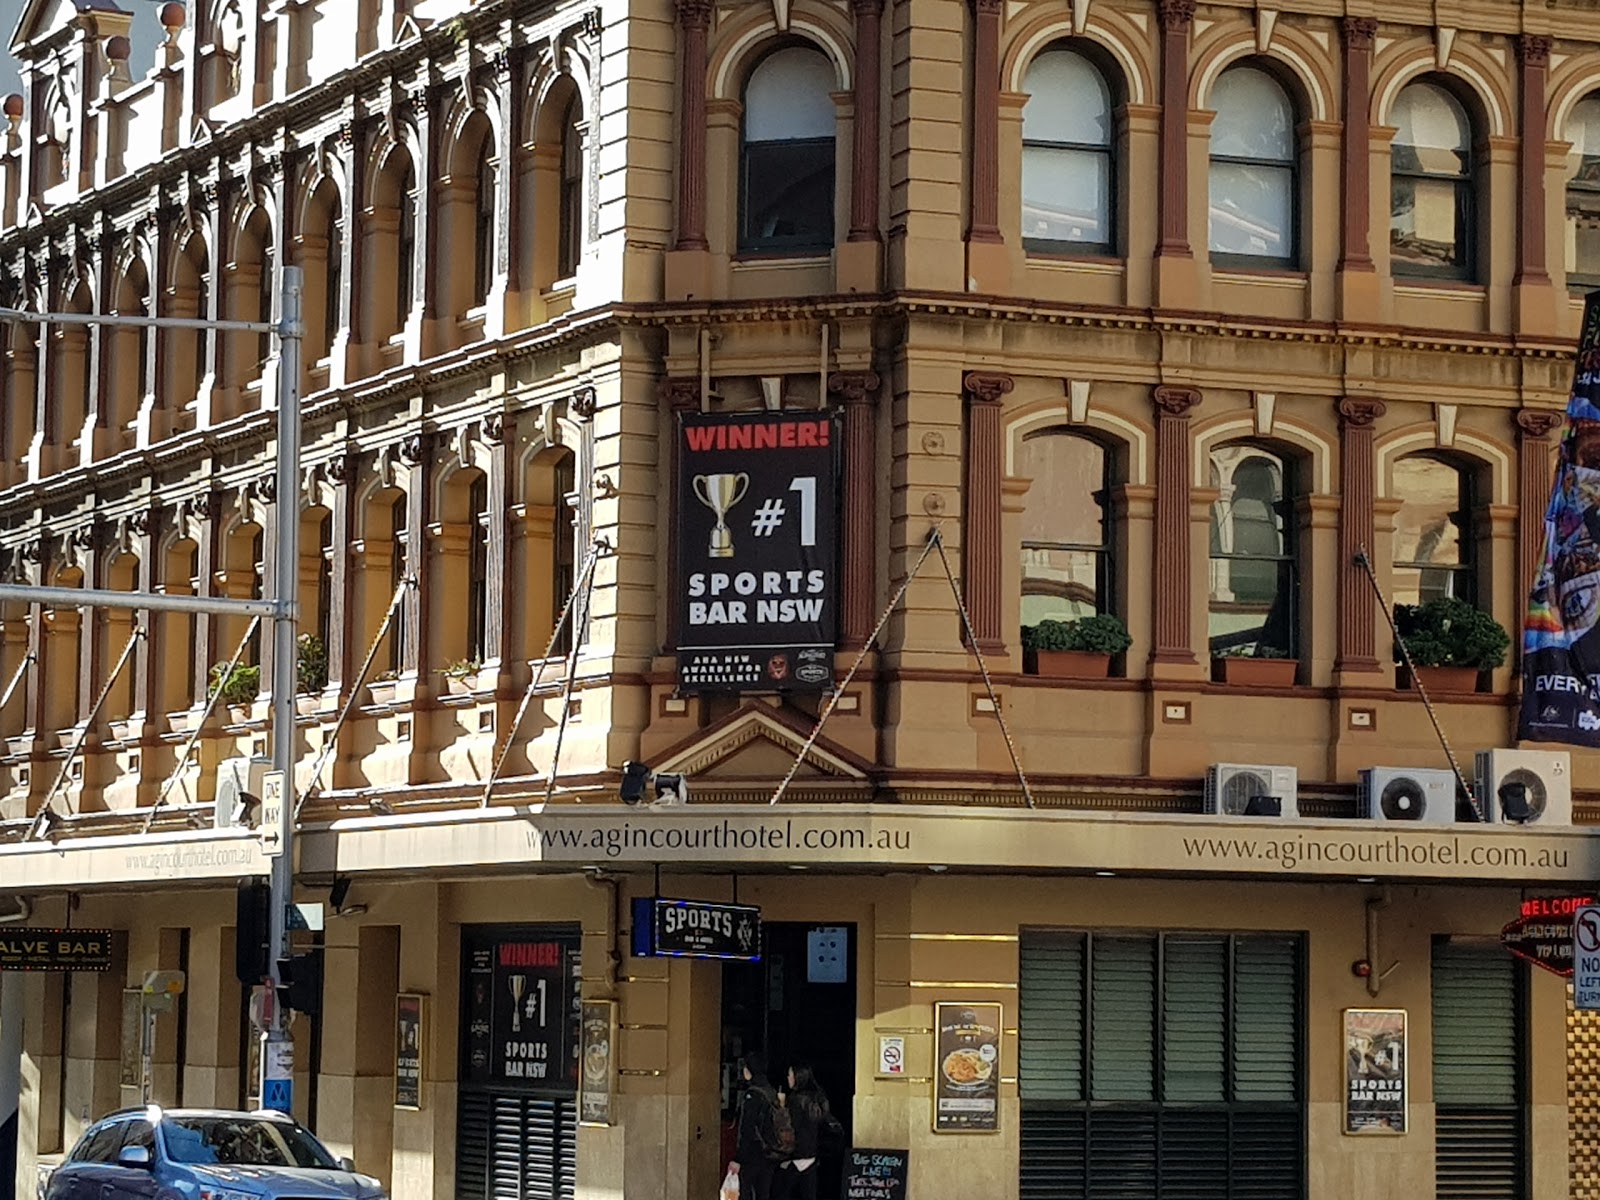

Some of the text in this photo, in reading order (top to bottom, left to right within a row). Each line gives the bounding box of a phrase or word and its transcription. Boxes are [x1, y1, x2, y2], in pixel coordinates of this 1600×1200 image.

[685, 420, 830, 451] WINNER!
[752, 477, 817, 546] #1
[688, 570, 825, 597] SPORTS
[689, 599, 825, 625] BAR NSW
[682, 664, 762, 674] AWARDS FOR
[684, 674, 759, 683] EXCELLENCE
[526, 819, 911, 857] www.agincourthotel.com.au
[1182, 834, 1569, 869] www.agincourthotel.com.au
[665, 907, 732, 938] SPORTS
[58, 942, 101, 954] BAR
[1582, 957, 1600, 972] NO
[525, 979, 547, 1028] #1
[505, 1042, 548, 1060] SPORTS
[1374, 1041, 1401, 1071] #1
[505, 1061, 547, 1078] BAR NSW
[1351, 1079, 1403, 1090] SPORTS
[1351, 1090, 1374, 1101] BAR
